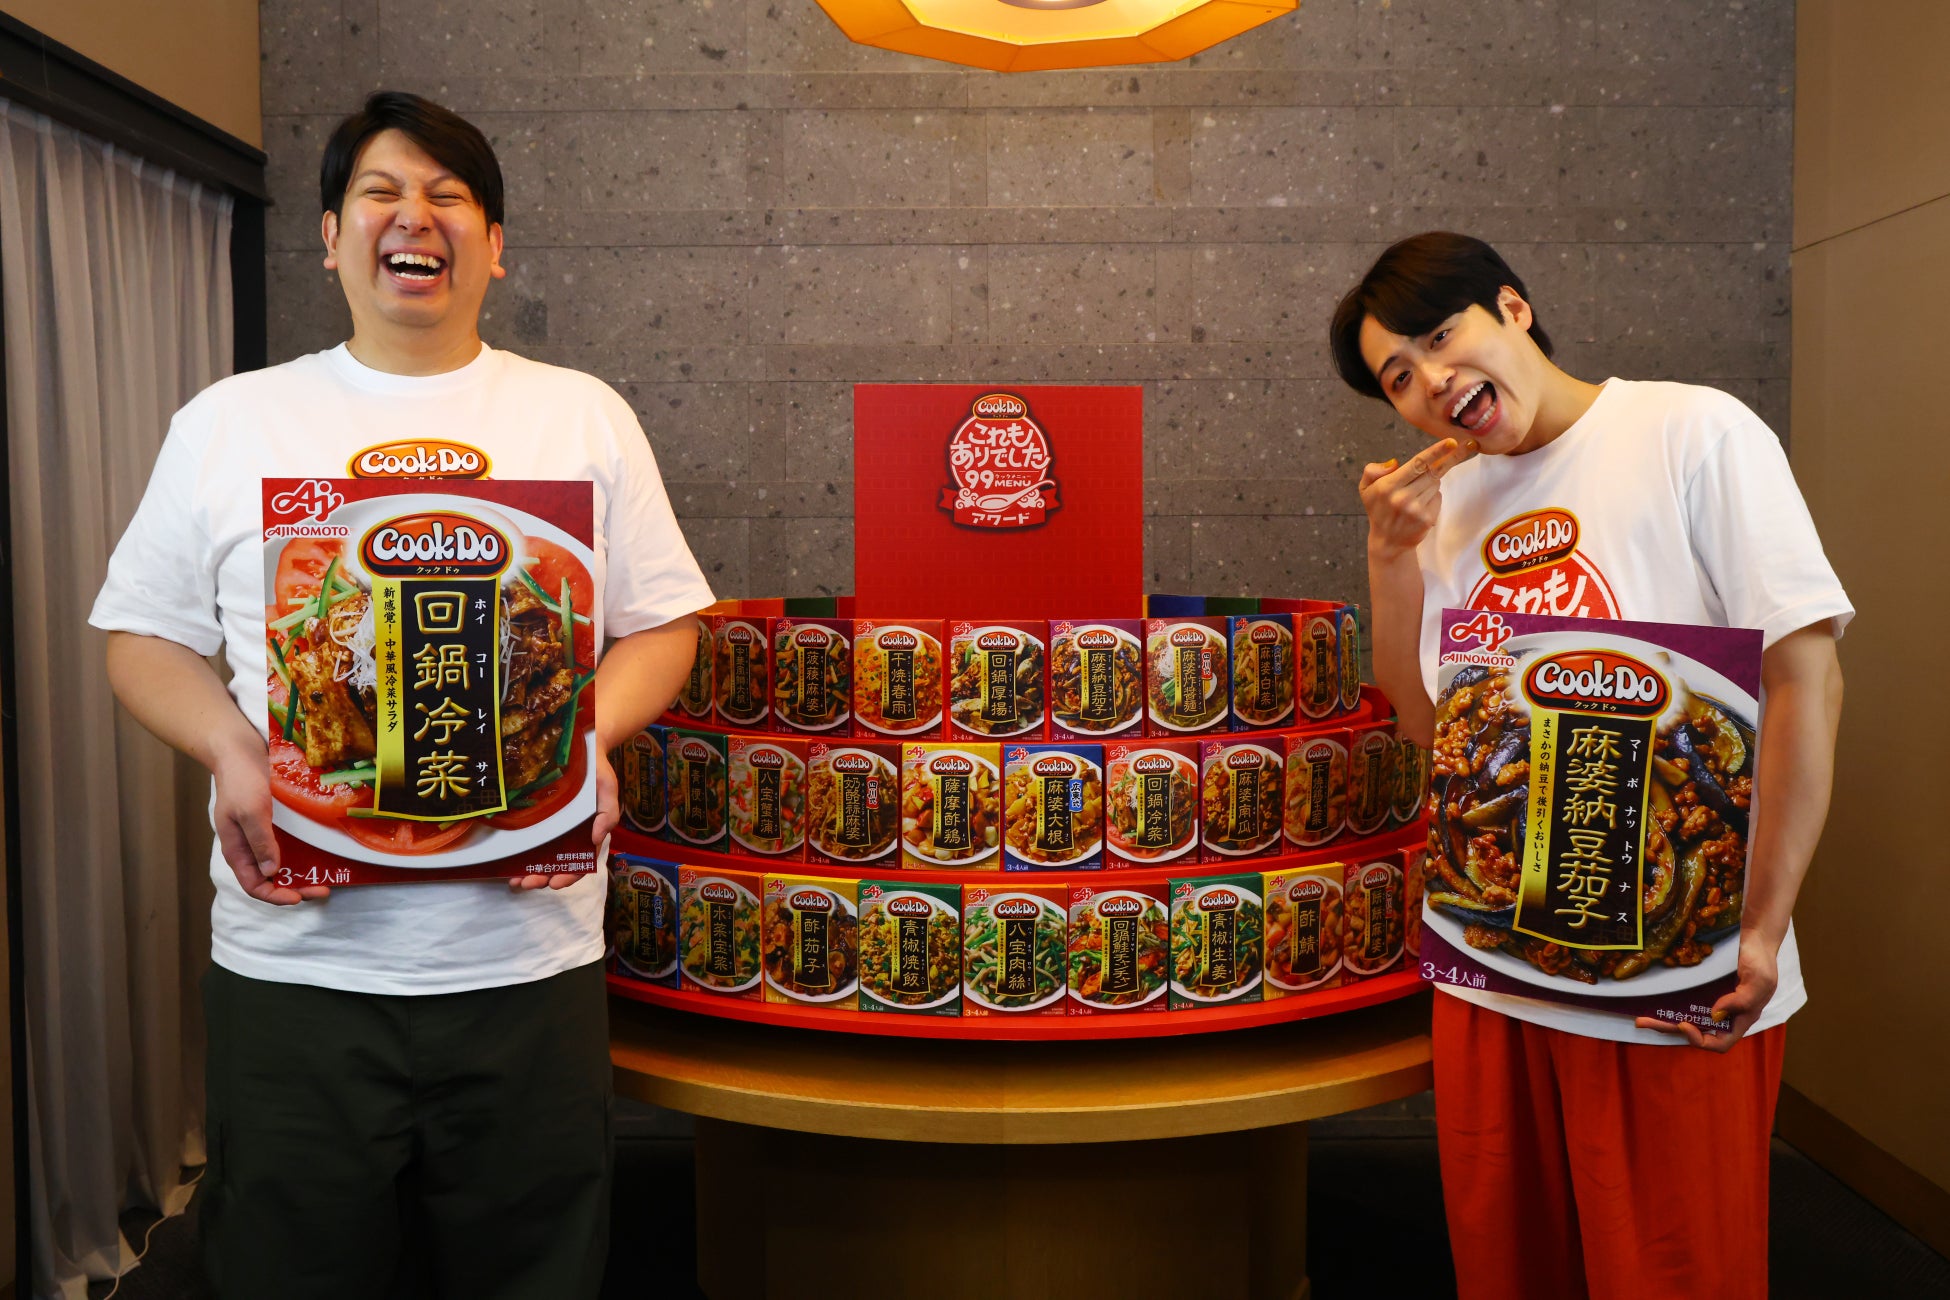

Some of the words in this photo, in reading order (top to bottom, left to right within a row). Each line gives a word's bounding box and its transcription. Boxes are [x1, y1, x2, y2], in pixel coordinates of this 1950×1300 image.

[950, 440, 1051, 470] ありでした
[968, 422, 1034, 447] これも
[965, 470, 994, 489] 99
[265, 526, 350, 538] AJINOMOTO
[971, 512, 1030, 526] アワード
[891, 652, 906, 715] 干焼春雨
[991, 654, 1007, 716] 回鍋厚揚
[1091, 652, 1107, 716] 麻婆納豆茄子
[1260, 647, 1271, 706] 麻婆白菜
[1442, 653, 1515, 667] AJINOMOTO
[412, 590, 471, 800] 回鍋冷菜
[943, 778, 961, 844] 薩摩酢鶏
[1047, 779, 1064, 845] 麻婆大根
[1147, 777, 1163, 841] 回鍋冷菜
[1238, 771, 1252, 835] 麻婆南瓜
[1532, 718, 1552, 873] まさかの納豆で後引くおいしさ
[1554, 725, 1623, 929] 麻婆納豆茄子
[526, 862, 595, 873] 中華合わせ調味料
[556, 852, 595, 862] 使用料理例
[804, 918, 821, 973] 酢茄子
[902, 920, 919, 987] 青椒焼飯
[1008, 922, 1026, 990] 八宝肉絲
[1113, 921, 1130, 989] 回鍋鮭チャンチャン
[1211, 913, 1227, 981] 青椒生姜
[1300, 910, 1316, 955] 酢鯖
